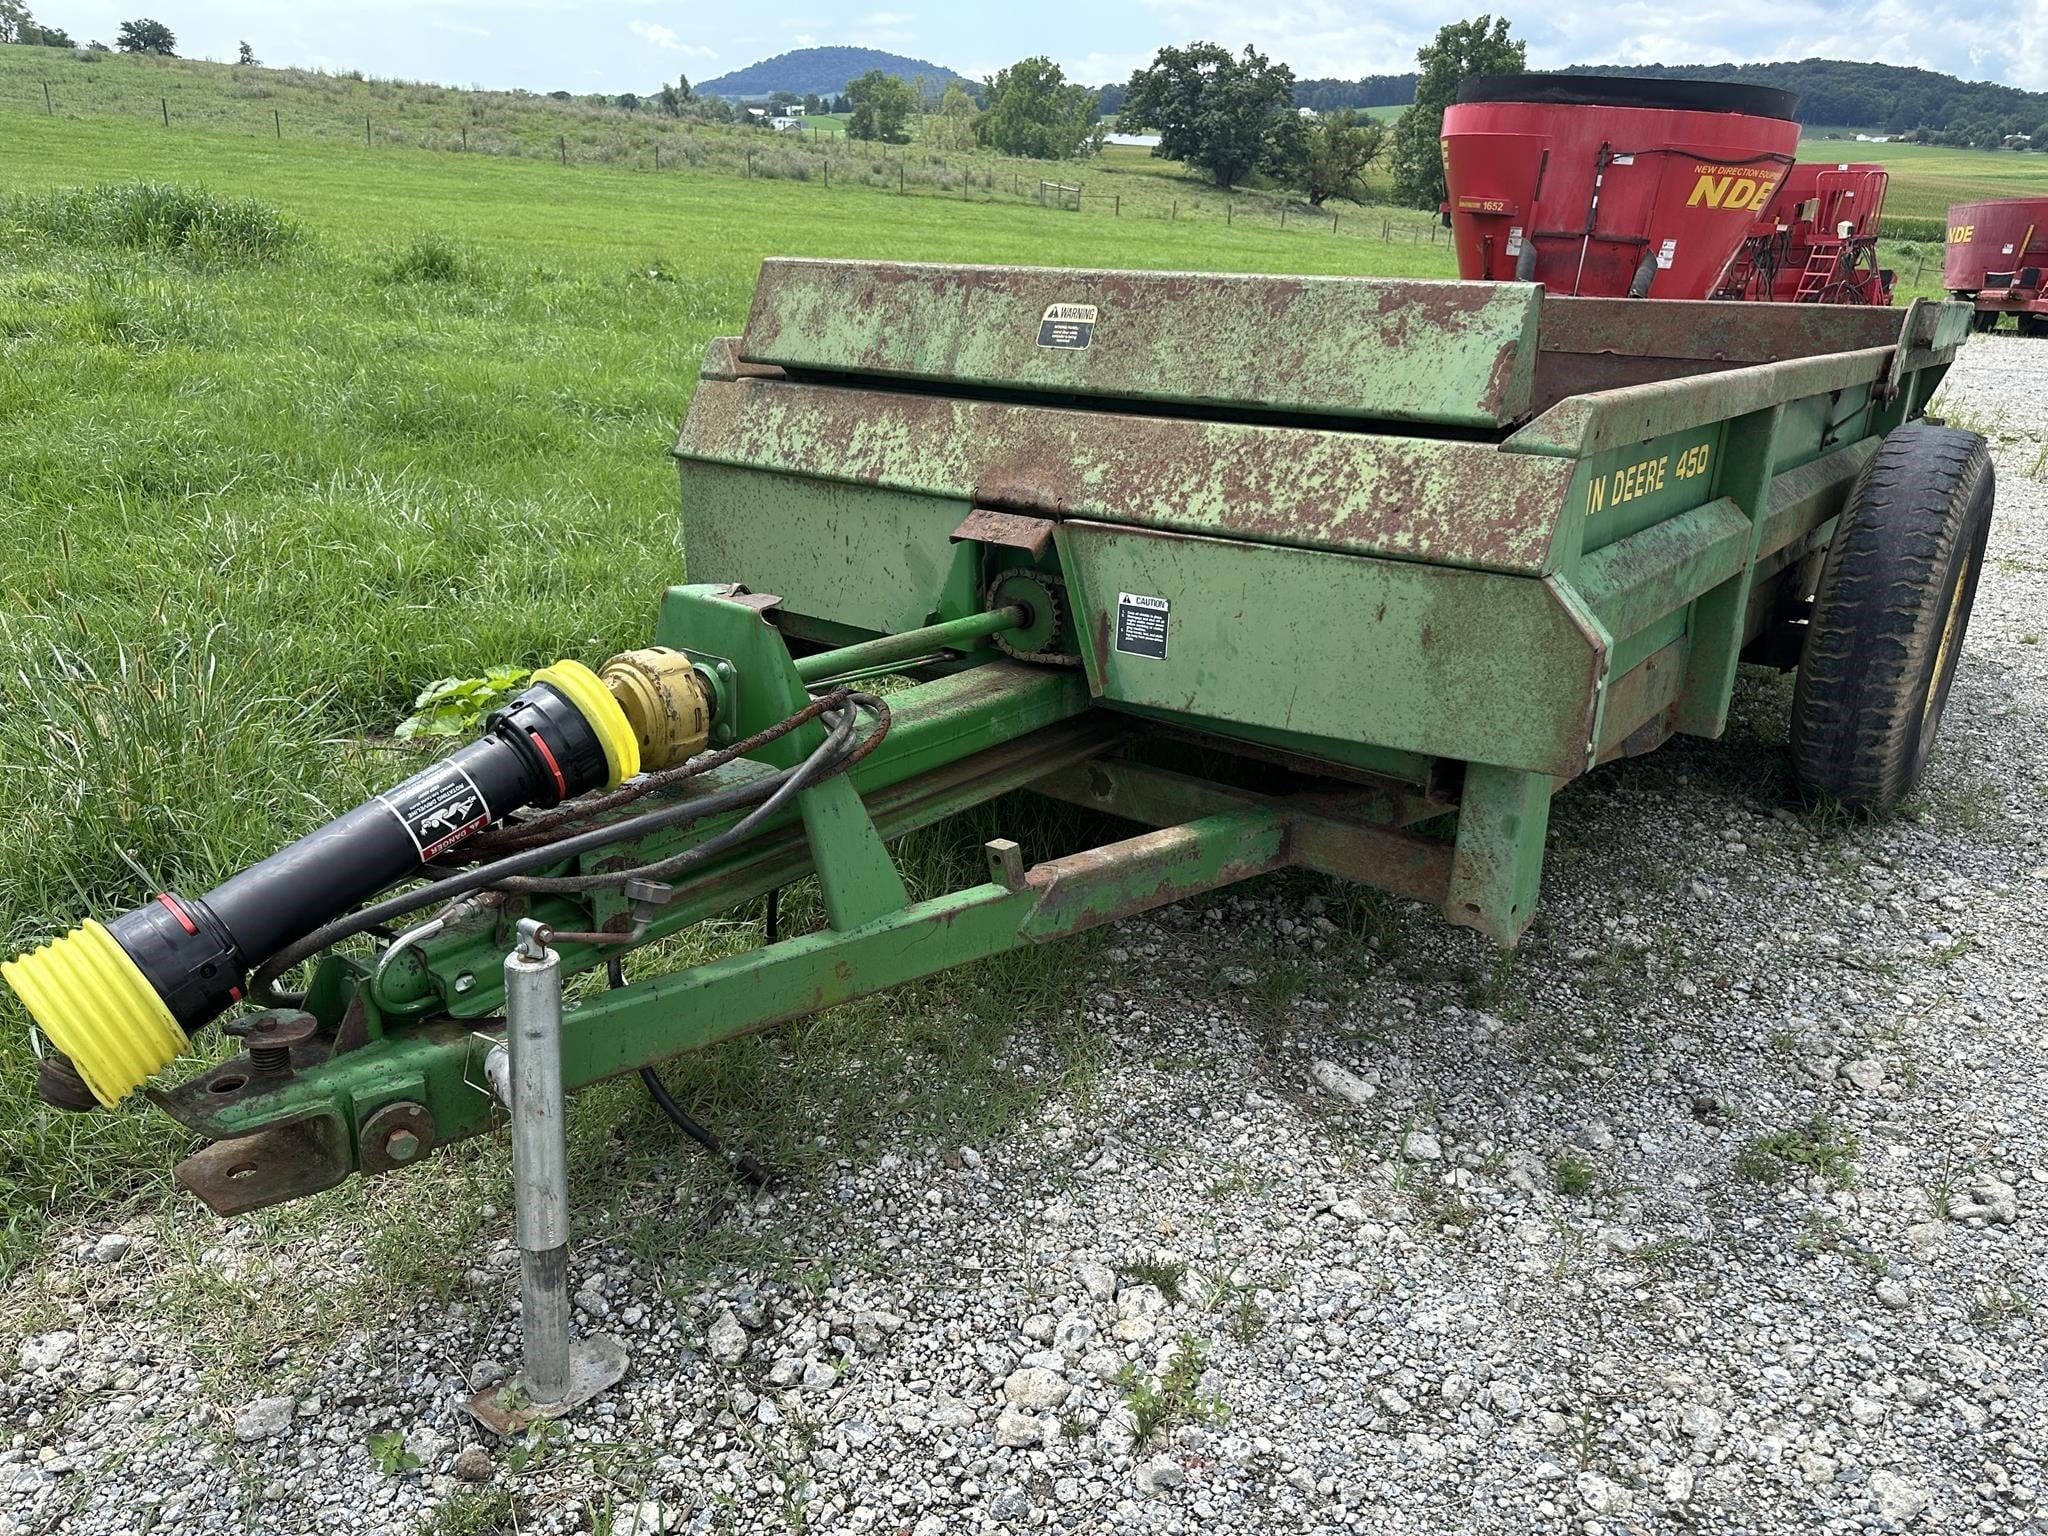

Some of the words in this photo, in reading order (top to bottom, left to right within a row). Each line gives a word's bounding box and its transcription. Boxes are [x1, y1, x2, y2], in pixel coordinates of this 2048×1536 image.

[1694, 165, 1717, 174] NEW
[1717, 166, 1759, 177] DIRECTION
[1686, 175, 1776, 212] NDE
[1482, 200, 1504, 212] 1652
[1947, 225, 1975, 244] NDE
[1060, 306, 1095, 320] WARNING
[1611, 455, 1668, 507] DEERE
[1675, 444, 1709, 480] 450
[1135, 596, 1165, 609] CAUTION
[436, 783, 465, 801] ROTATING
[407, 798, 437, 819] DRIVELINE
[430, 830, 467, 855] DANGER
